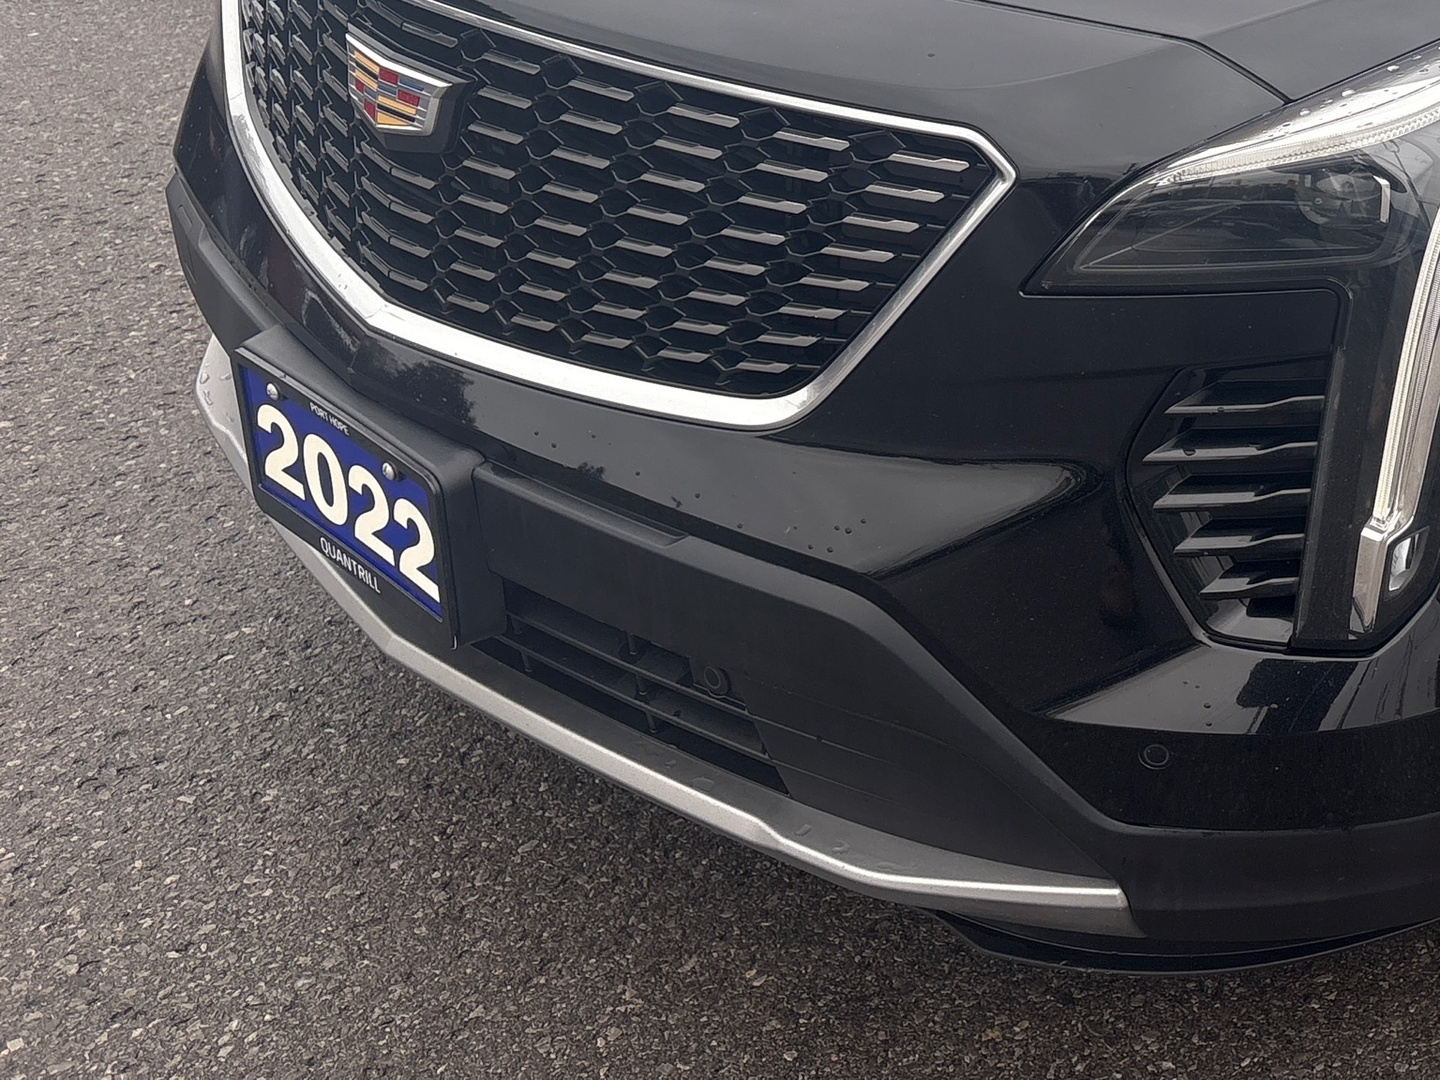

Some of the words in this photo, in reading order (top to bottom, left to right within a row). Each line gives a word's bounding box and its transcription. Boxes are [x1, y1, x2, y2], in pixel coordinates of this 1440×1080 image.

[310, 403, 329, 421] PORT
[329, 415, 350, 436] HOPE
[256, 403, 441, 604] 2022
[319, 536, 381, 594] QUANTRILL
